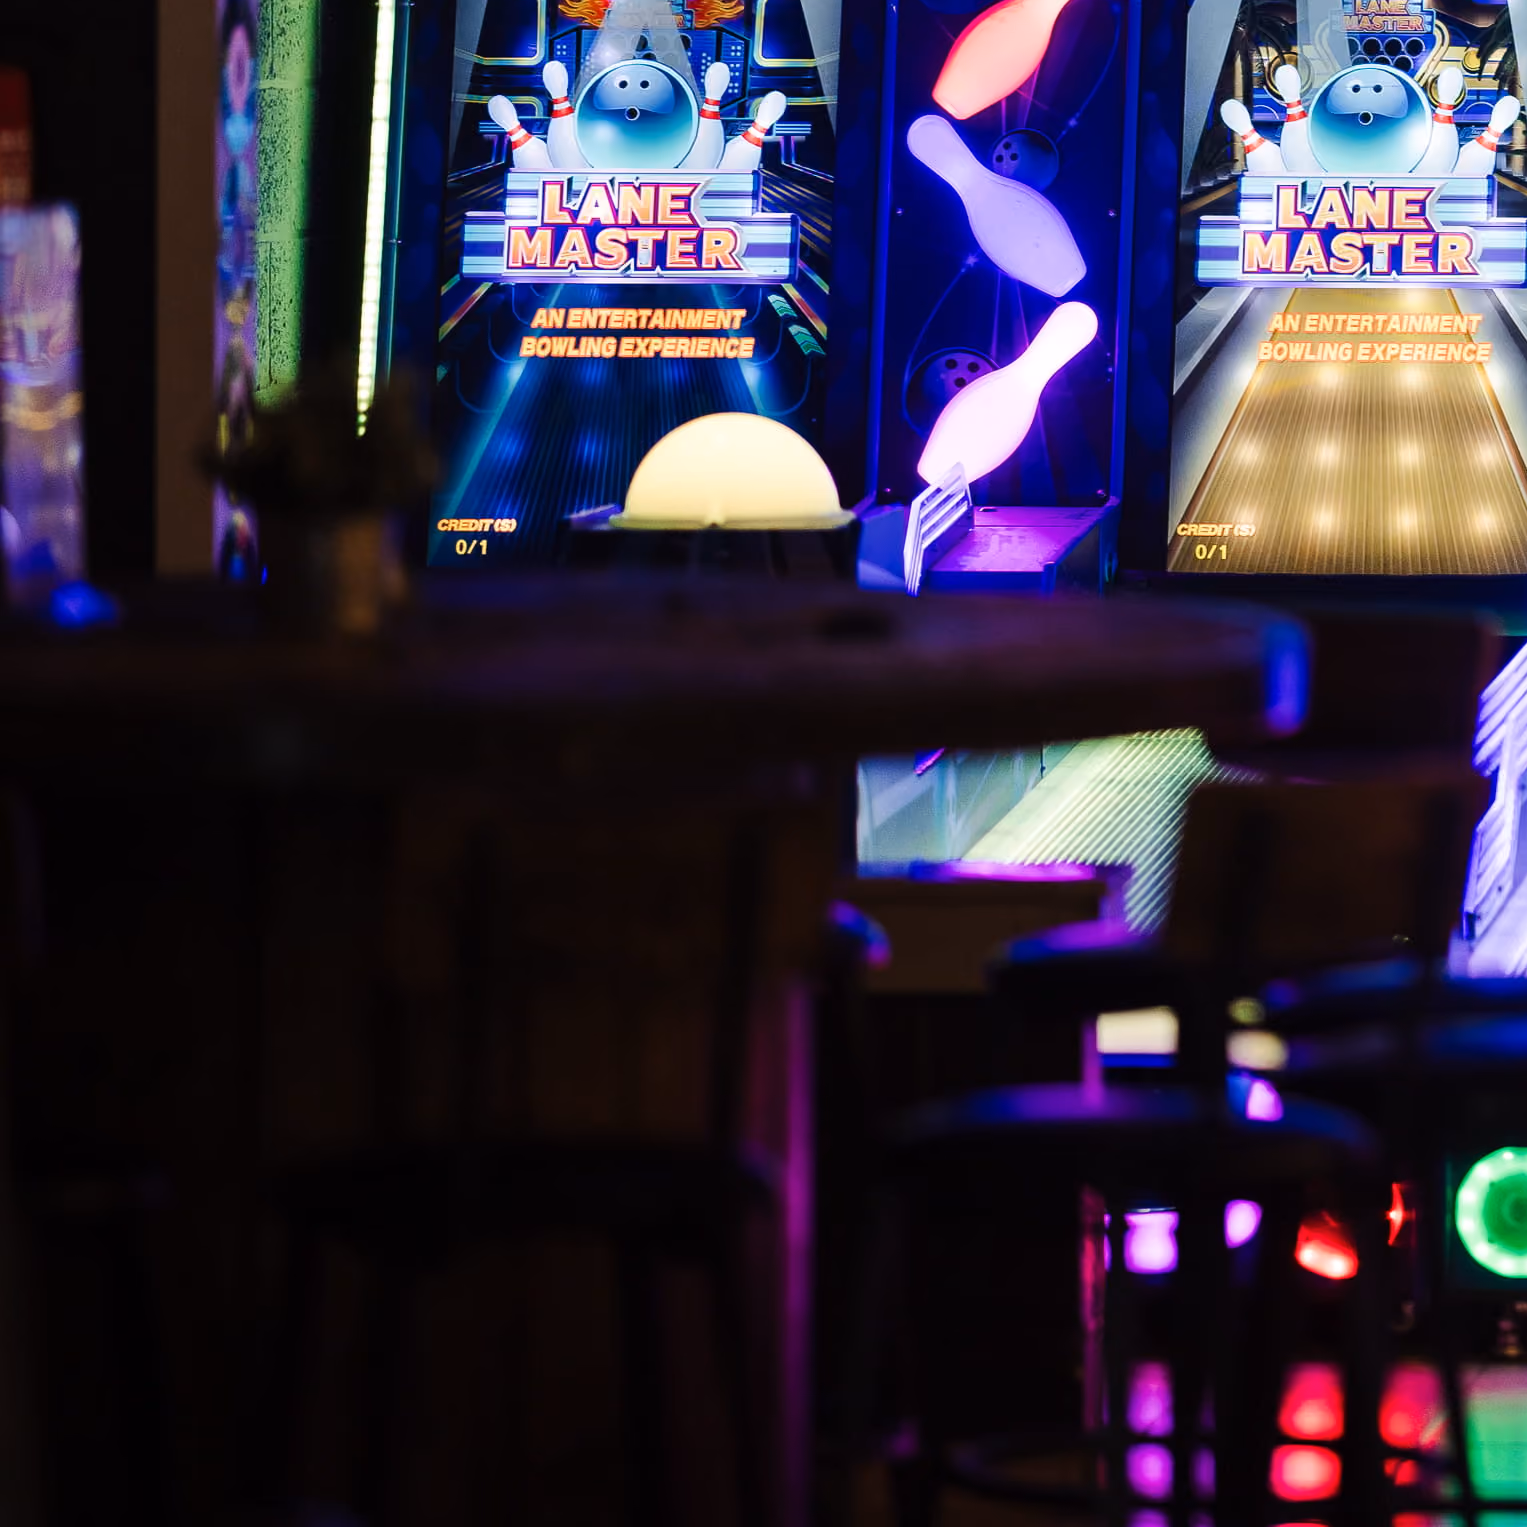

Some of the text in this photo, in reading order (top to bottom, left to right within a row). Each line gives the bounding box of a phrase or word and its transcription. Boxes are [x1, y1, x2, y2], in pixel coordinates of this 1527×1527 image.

[1354, 0, 1408, 14] LANE
[1344, 15, 1424, 31] MASTER
[542, 181, 701, 224] LANE
[1277, 185, 1436, 229] LANE
[508, 227, 743, 270] MASTER
[1243, 232, 1479, 275] MASTER
[530, 308, 747, 330] AN ENTERTAINMENT
[1269, 313, 1483, 335] AN ENTERTAINMENT
[519, 336, 755, 359] BOWLING EXPERIENCE
[1258, 341, 1492, 363] BOWLING EXPERIENCE
[456, 539, 487, 555] 0/1
[1195, 544, 1227, 559] 0/1
